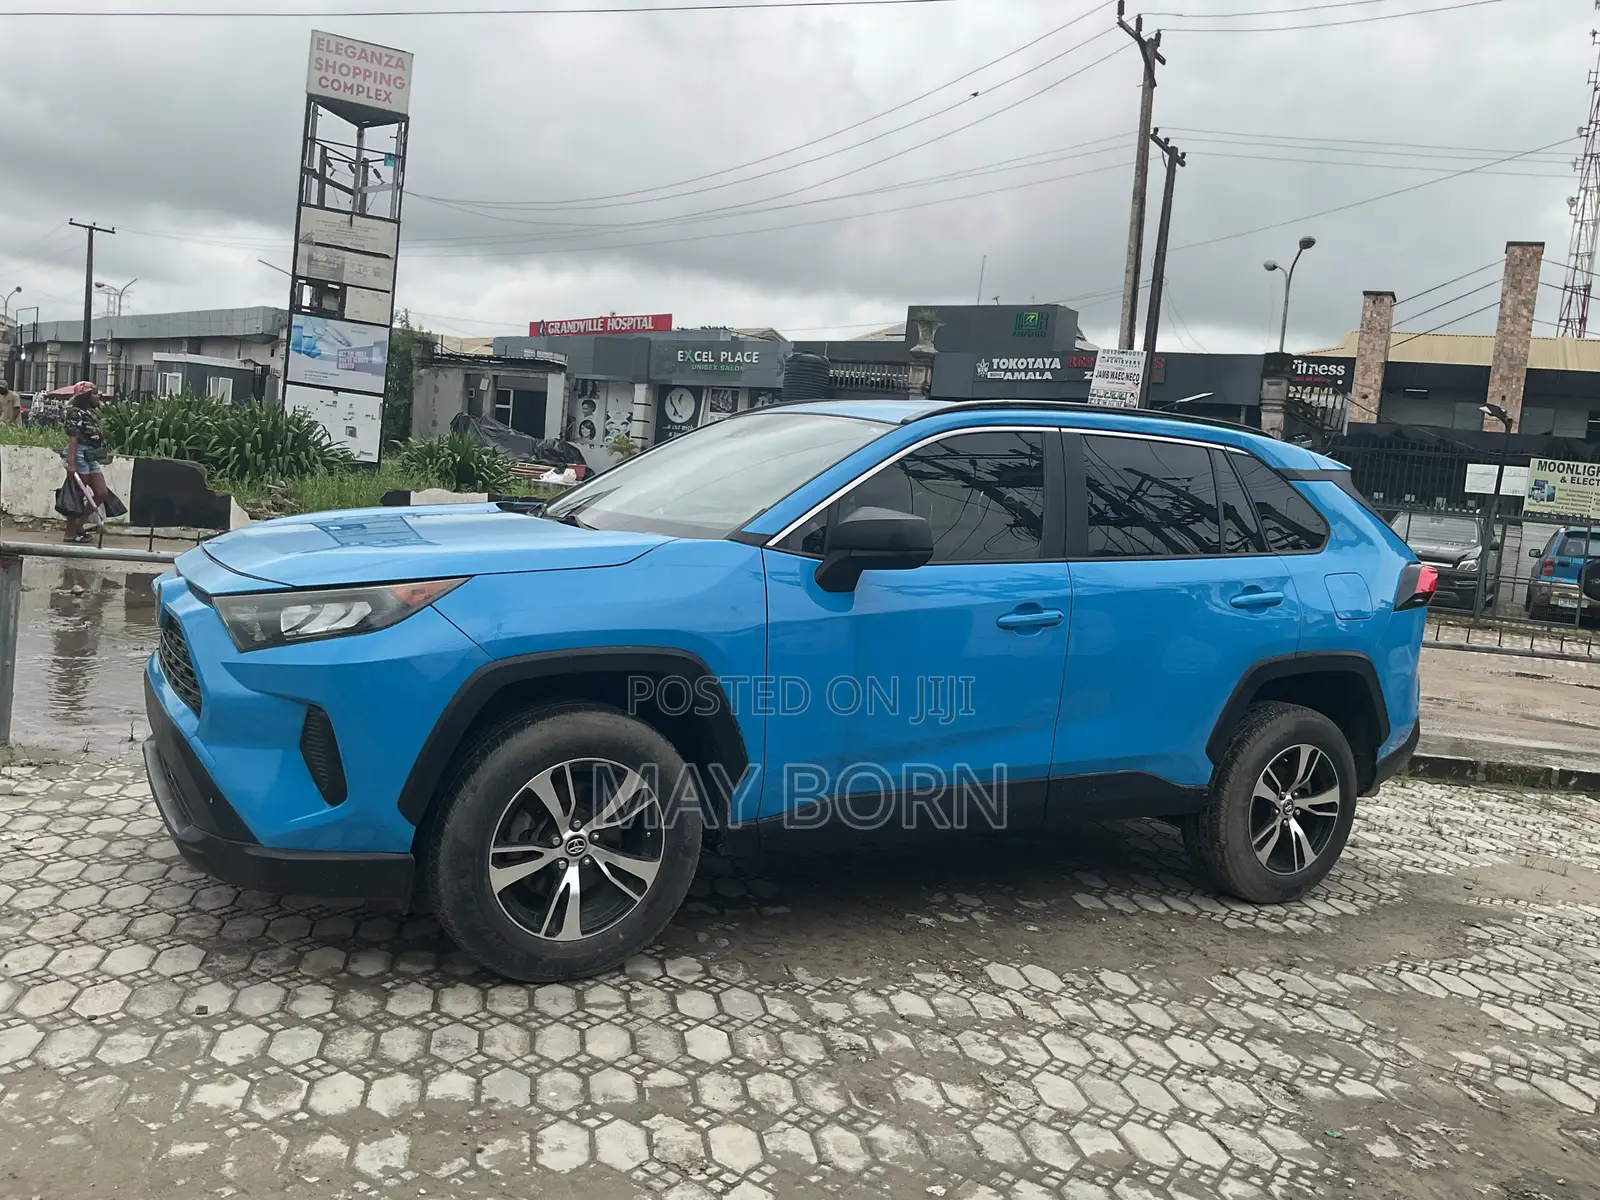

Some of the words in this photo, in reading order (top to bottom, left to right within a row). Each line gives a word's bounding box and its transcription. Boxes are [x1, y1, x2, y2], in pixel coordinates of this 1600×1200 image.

[315, 37, 407, 71] ELEGANZA
[314, 57, 406, 90] SHOPPING
[318, 75, 393, 103] COMPLEX
[548, 318, 604, 335] GRANDVILLE
[607, 316, 655, 331] HOSPITAL
[677, 349, 715, 363] EXCEL
[720, 351, 760, 363] PLACE
[720, 364, 745, 372] SALON
[992, 357, 1061, 369] TOKOTAYA
[1003, 371, 1053, 380] AMALA
[1095, 370, 1110, 379] JAMB
[1110, 371, 1125, 381] WAEC
[1126, 372, 1140, 382] NECO
[1560, 476, 1567, 484] &
